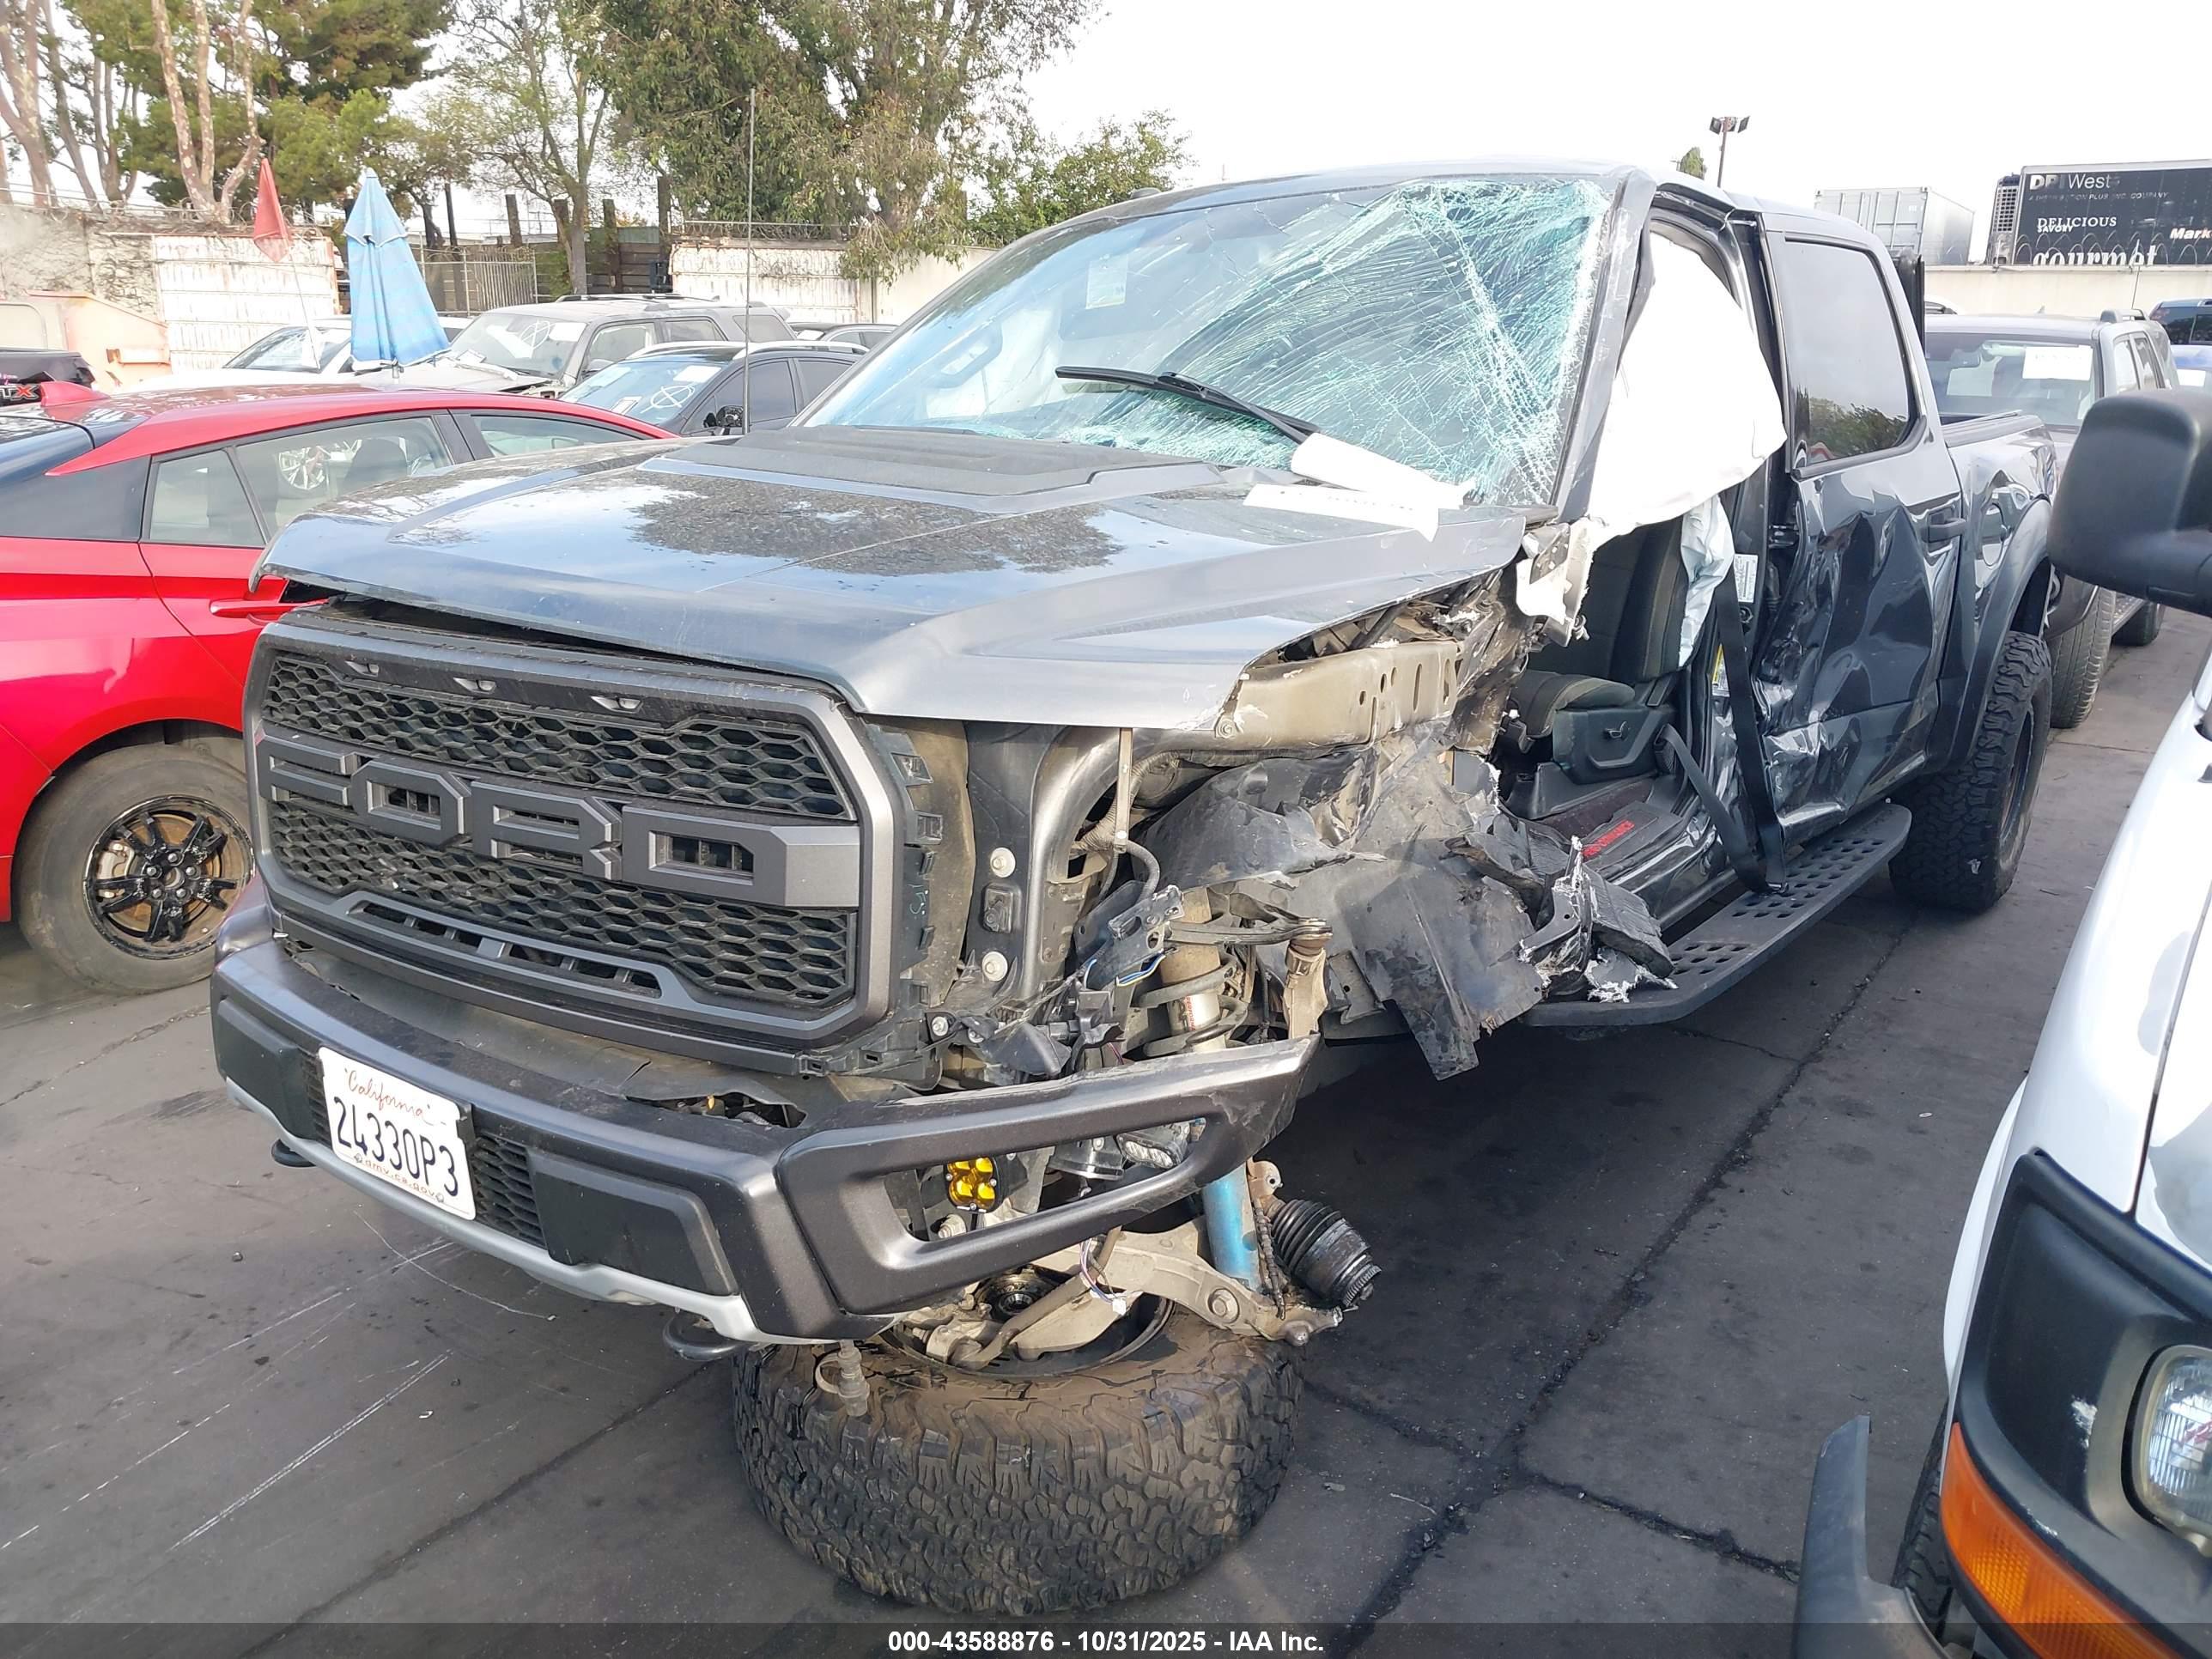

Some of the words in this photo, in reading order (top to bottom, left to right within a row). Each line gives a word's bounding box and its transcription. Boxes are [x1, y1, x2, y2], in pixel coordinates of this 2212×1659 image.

[2068, 173, 2110, 189] West
[2037, 216, 2118, 228] DELICIOUS
[2169, 227, 2212, 240] Mark
[258, 726, 859, 908] FORD
[348, 1070, 424, 1117] California
[333, 1096, 459, 1198] 24330P3
[364, 1158, 436, 1200] dmv.ca.gov
